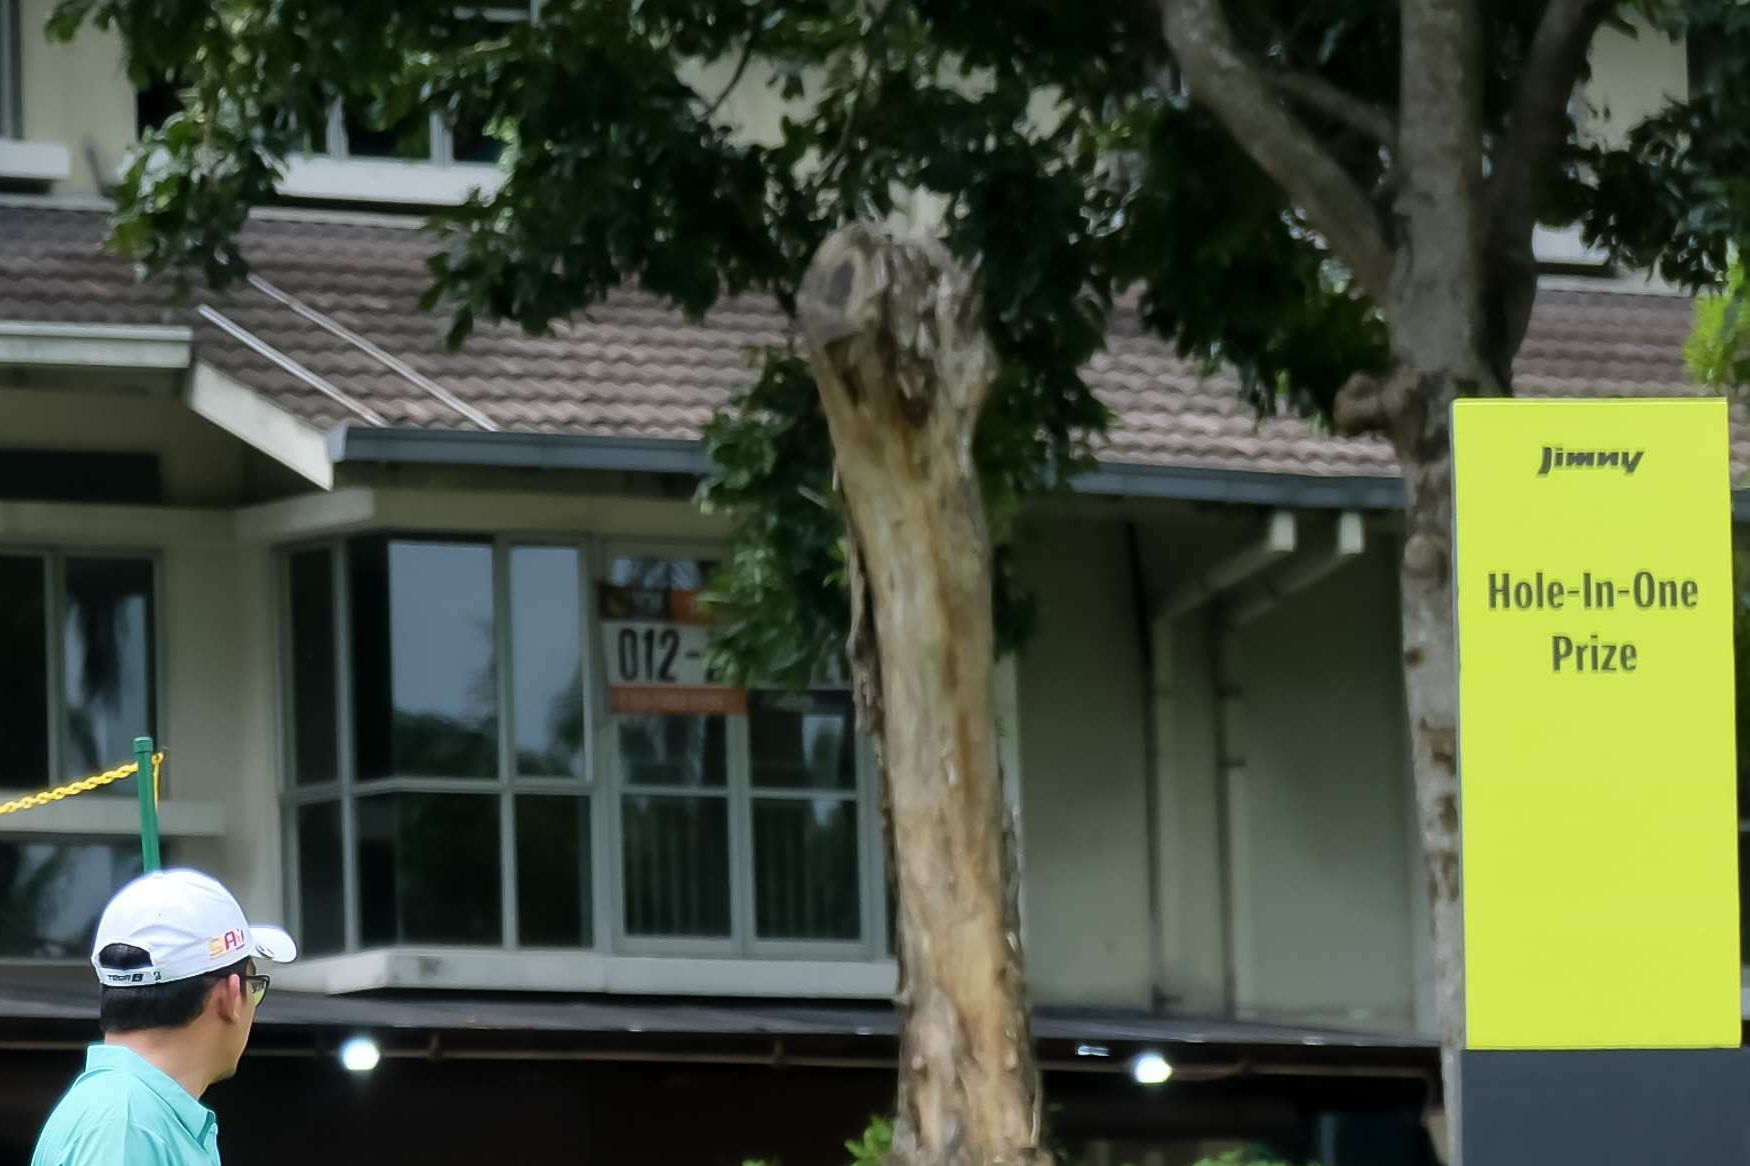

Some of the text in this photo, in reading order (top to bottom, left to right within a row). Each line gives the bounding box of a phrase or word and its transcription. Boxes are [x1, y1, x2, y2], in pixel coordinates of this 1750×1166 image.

[1537, 446, 1644, 476] Jimny
[1487, 571, 1698, 611] Hole-In-One
[1551, 633, 1638, 672] Prize
